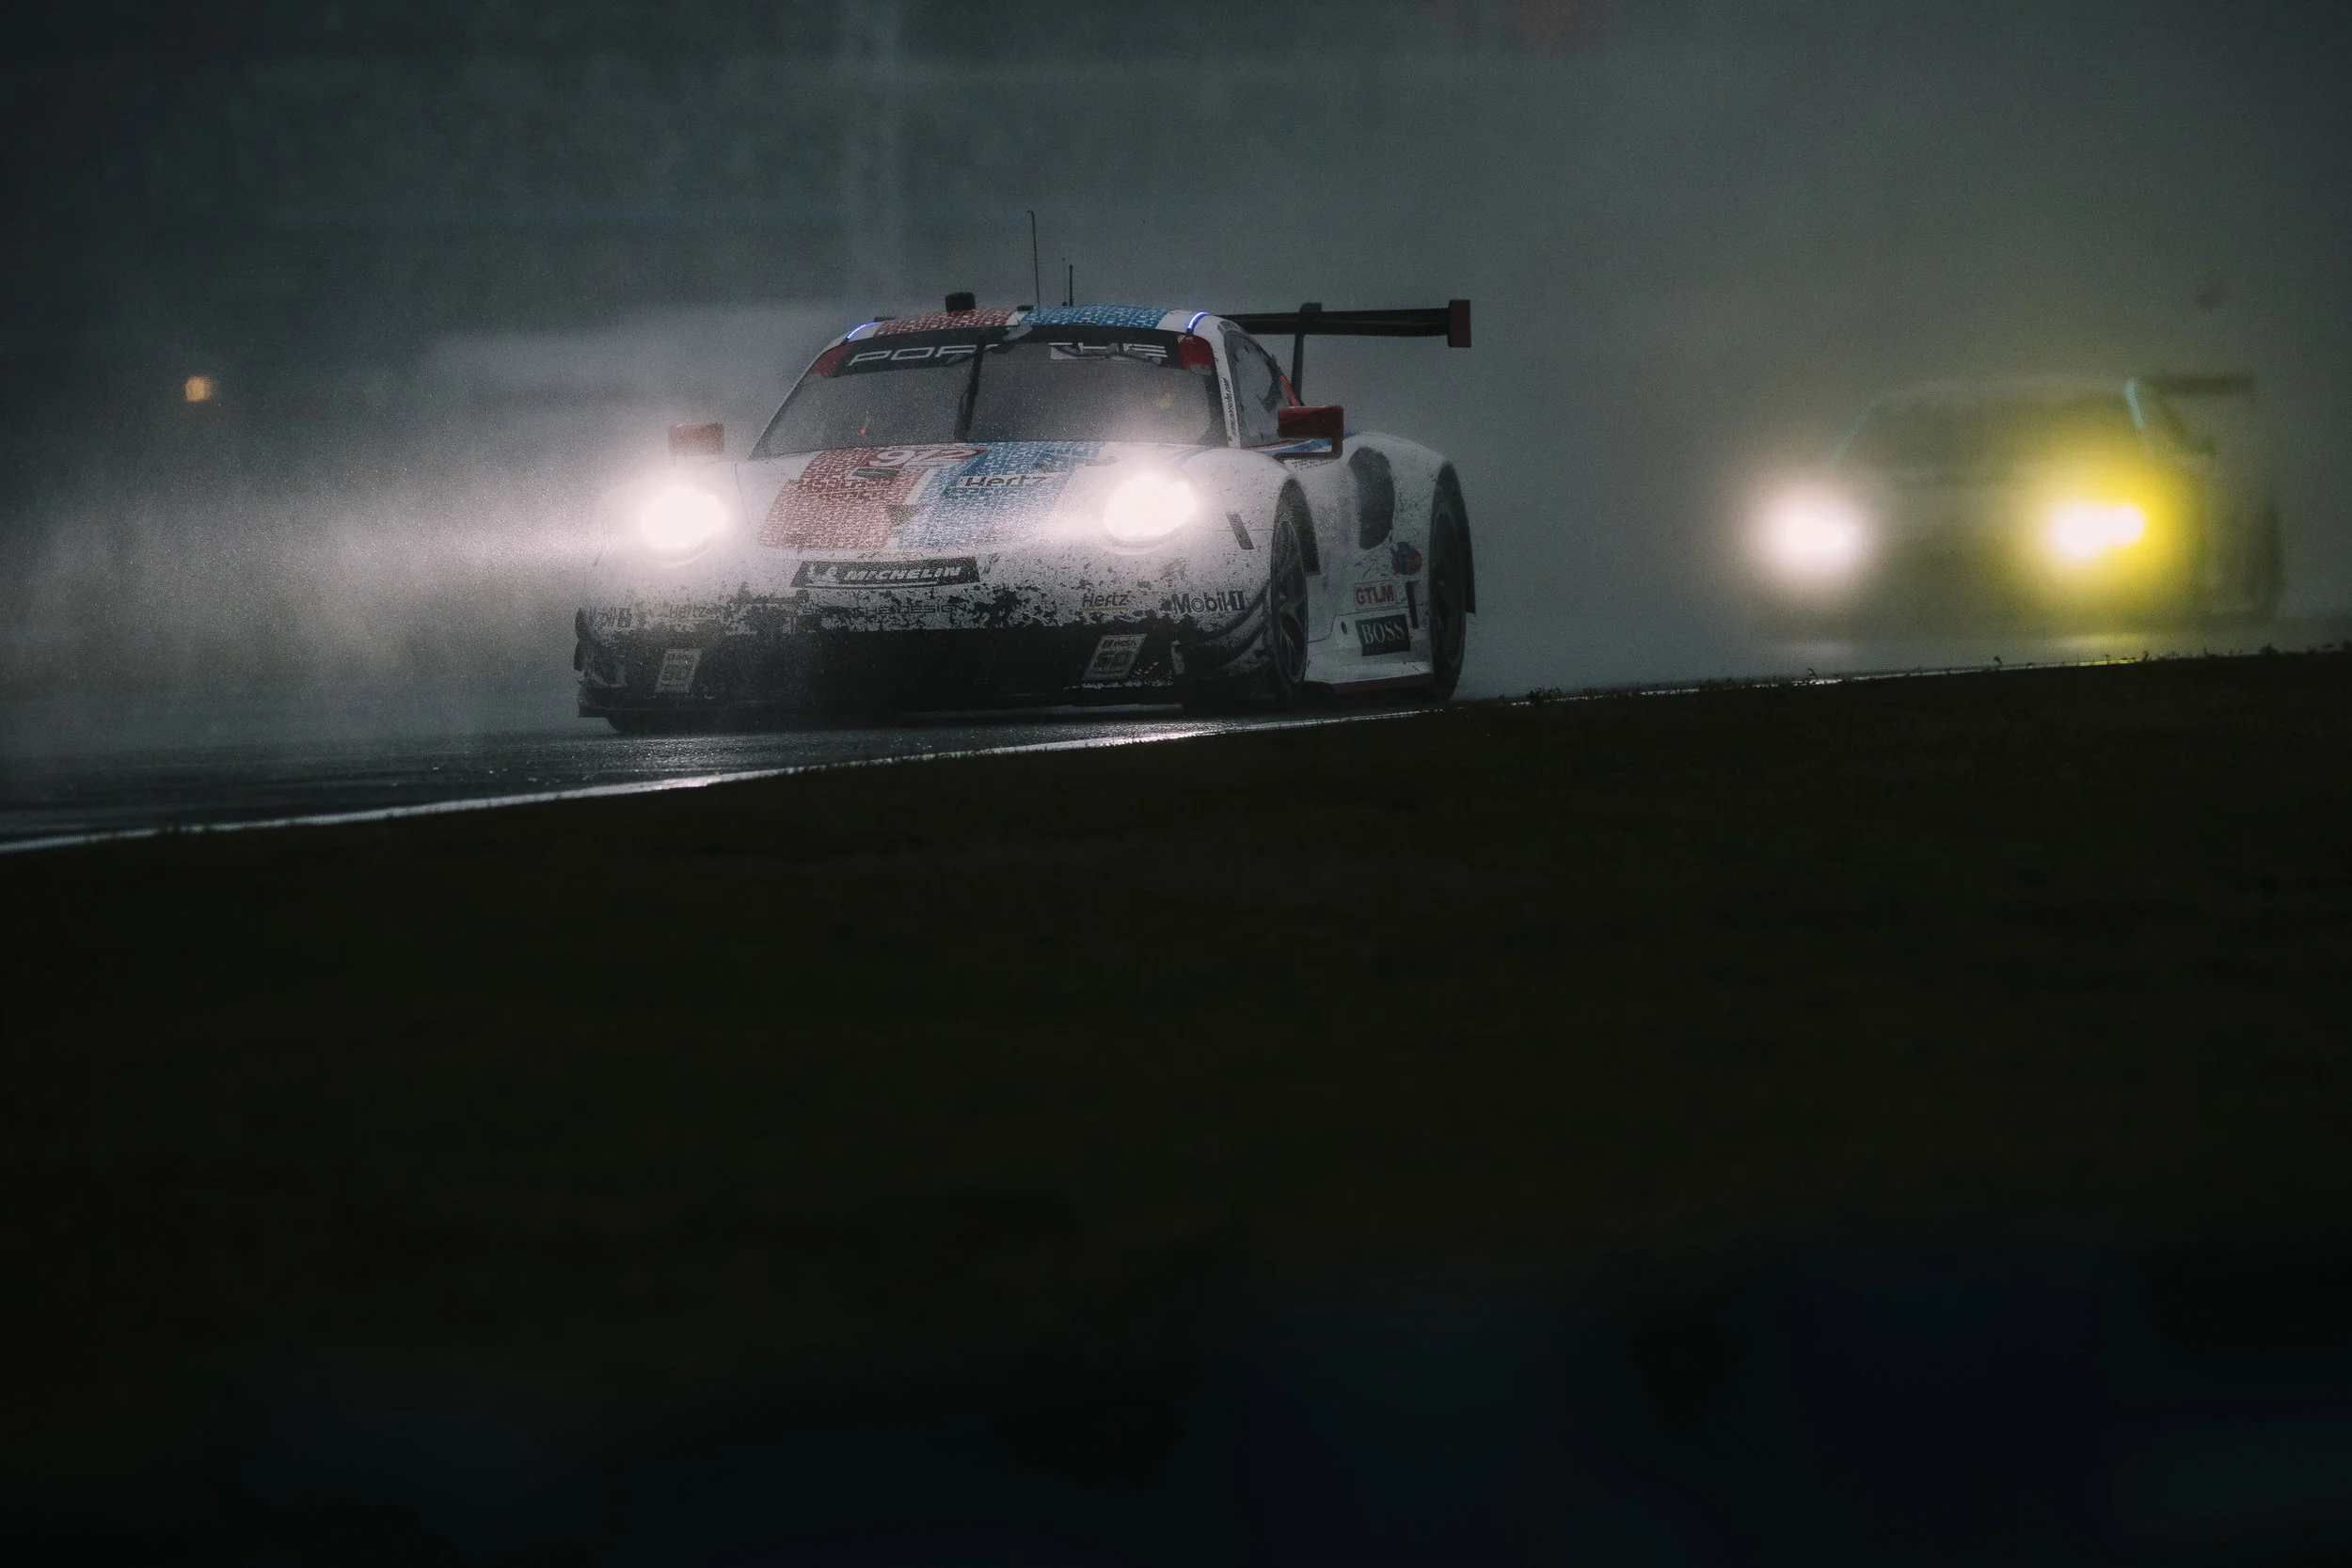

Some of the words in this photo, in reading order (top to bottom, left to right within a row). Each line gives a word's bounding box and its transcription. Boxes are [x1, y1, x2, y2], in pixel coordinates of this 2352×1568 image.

[964, 474, 1047, 488] Hertz
[844, 566, 962, 581] MICHELIN
[1082, 592, 1129, 608] Hertz
[1171, 591, 1228, 613] Mobil
[1356, 584, 1396, 605] GTLM
[1360, 621, 1406, 644] BOSS
